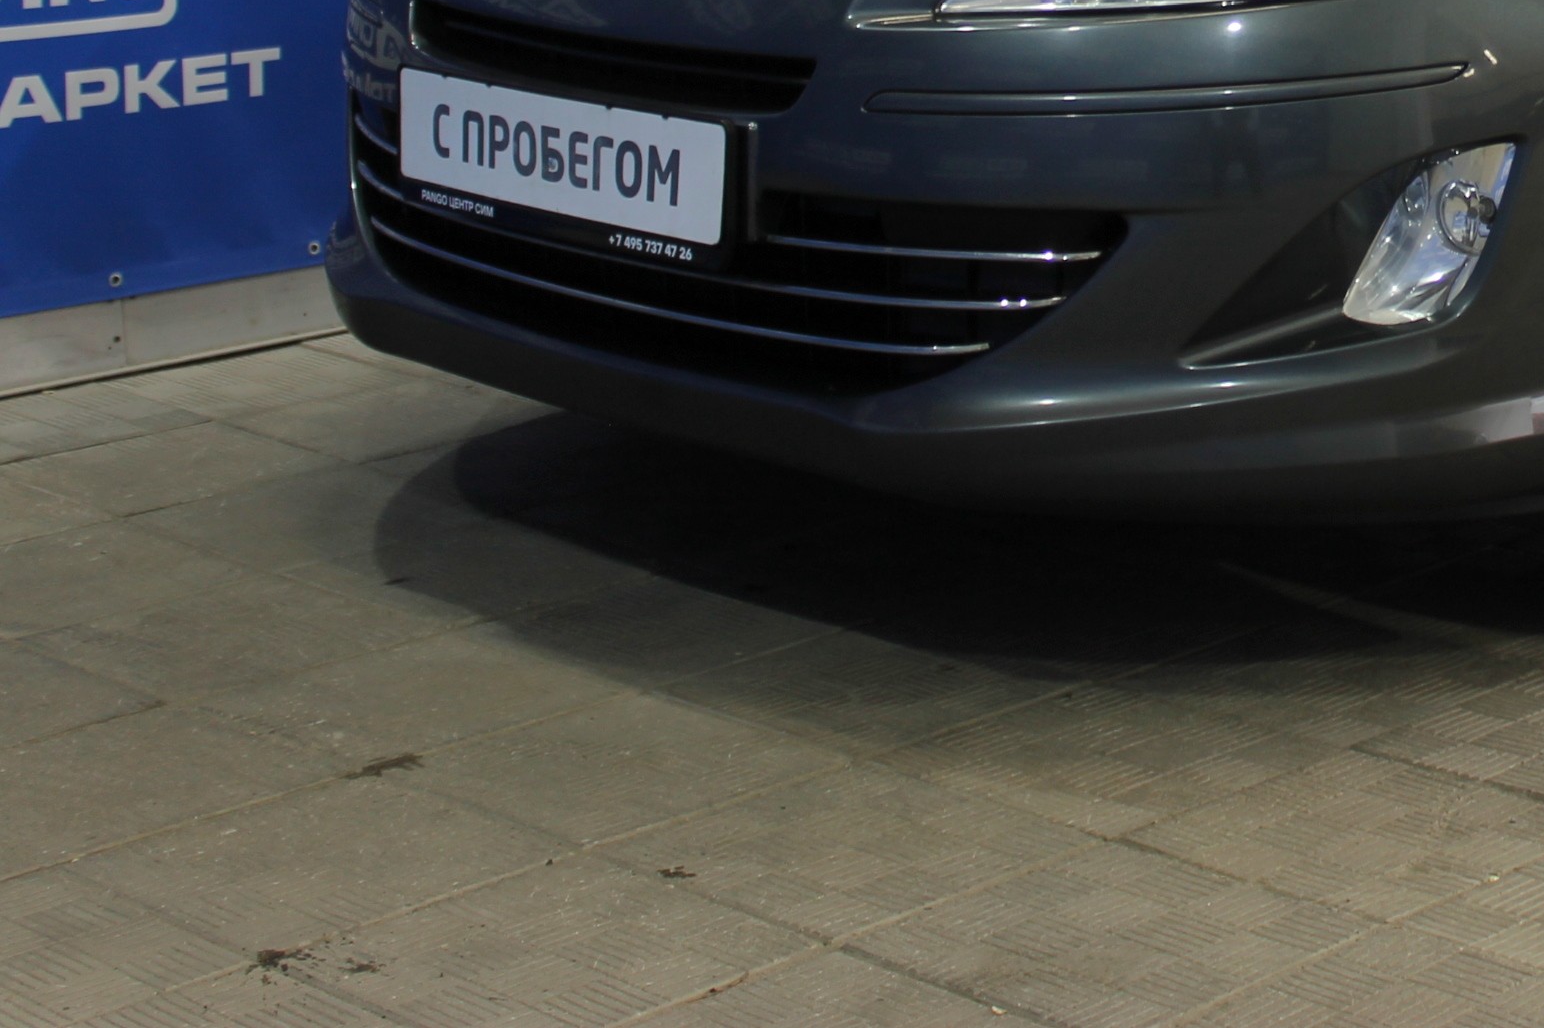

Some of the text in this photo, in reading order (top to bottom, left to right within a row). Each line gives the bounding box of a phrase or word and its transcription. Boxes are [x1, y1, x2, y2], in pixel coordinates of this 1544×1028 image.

[432, 103, 681, 207] С ПРОБЕГОМ
[421, 189, 494, 218] PANGO ЦЕНТР СИМ
[609, 234, 693, 261] +7 495 737 47 26
